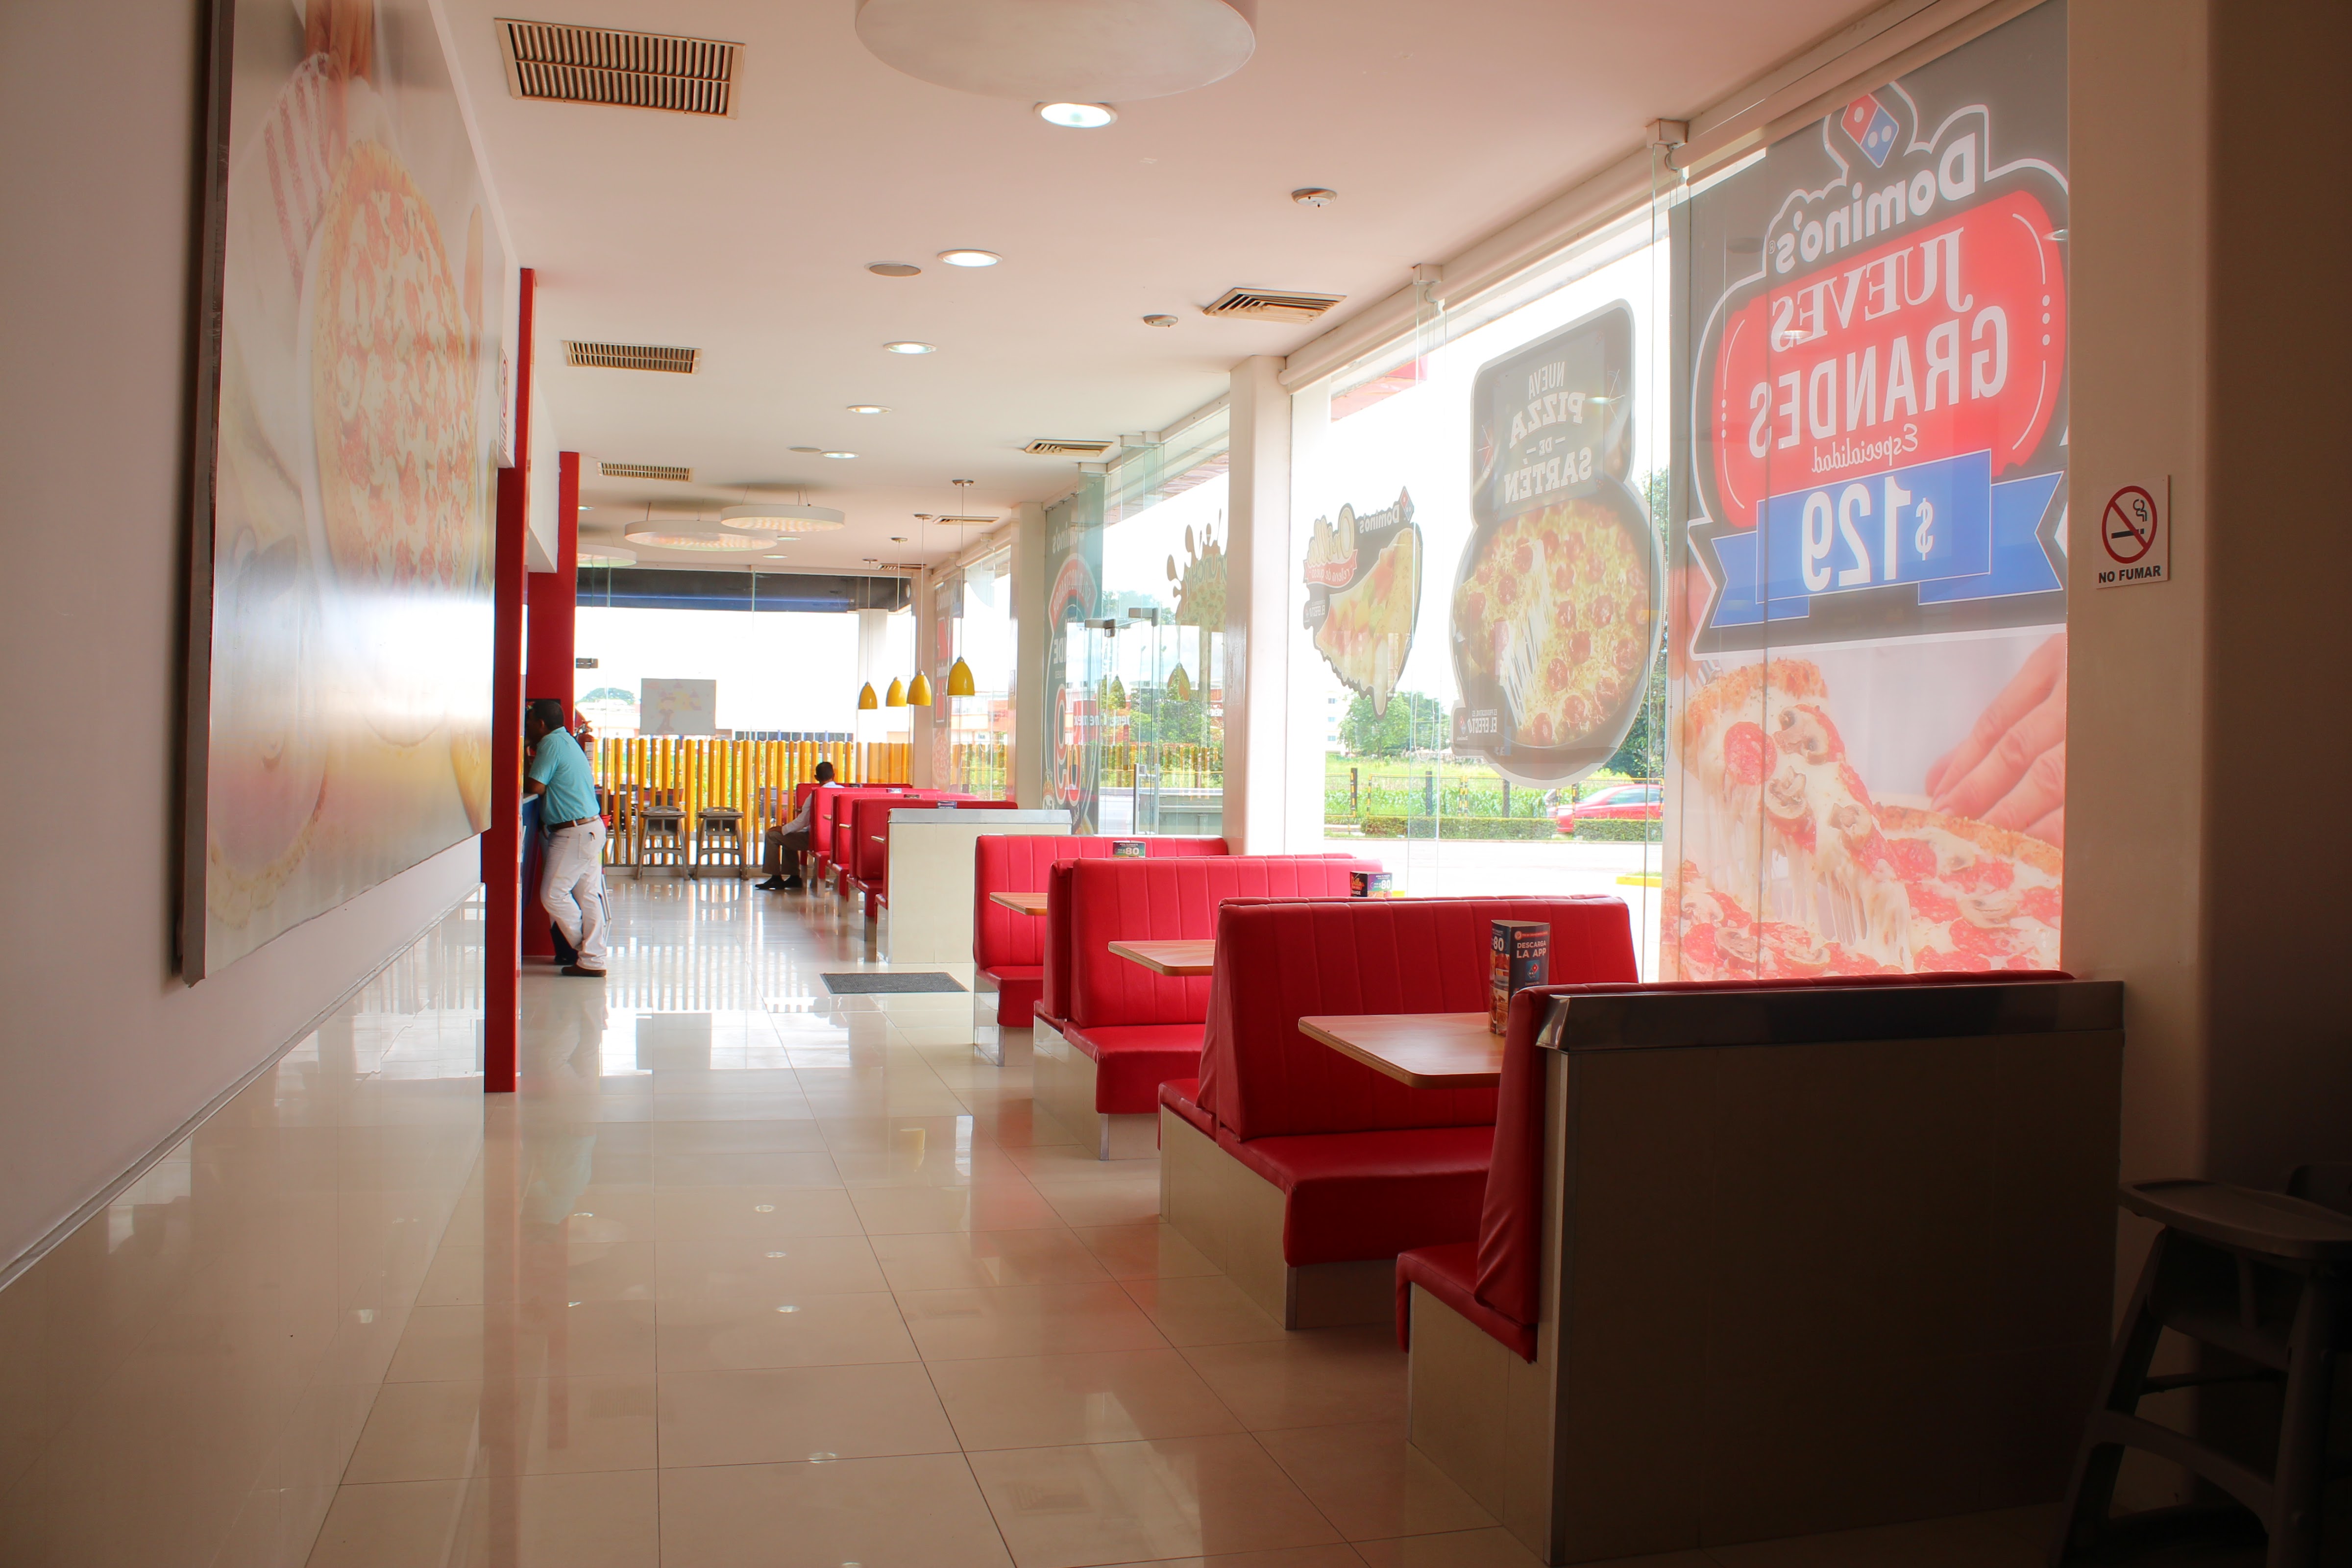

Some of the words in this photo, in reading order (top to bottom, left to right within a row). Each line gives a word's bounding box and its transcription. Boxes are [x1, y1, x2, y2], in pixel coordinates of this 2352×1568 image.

[2098, 571, 2115, 584] NO
[2119, 565, 2161, 581] FUMAR
[1517, 940, 1546, 949] DESCARGA
[1516, 950, 1530, 958] LA
[1532, 947, 1546, 957] APP
